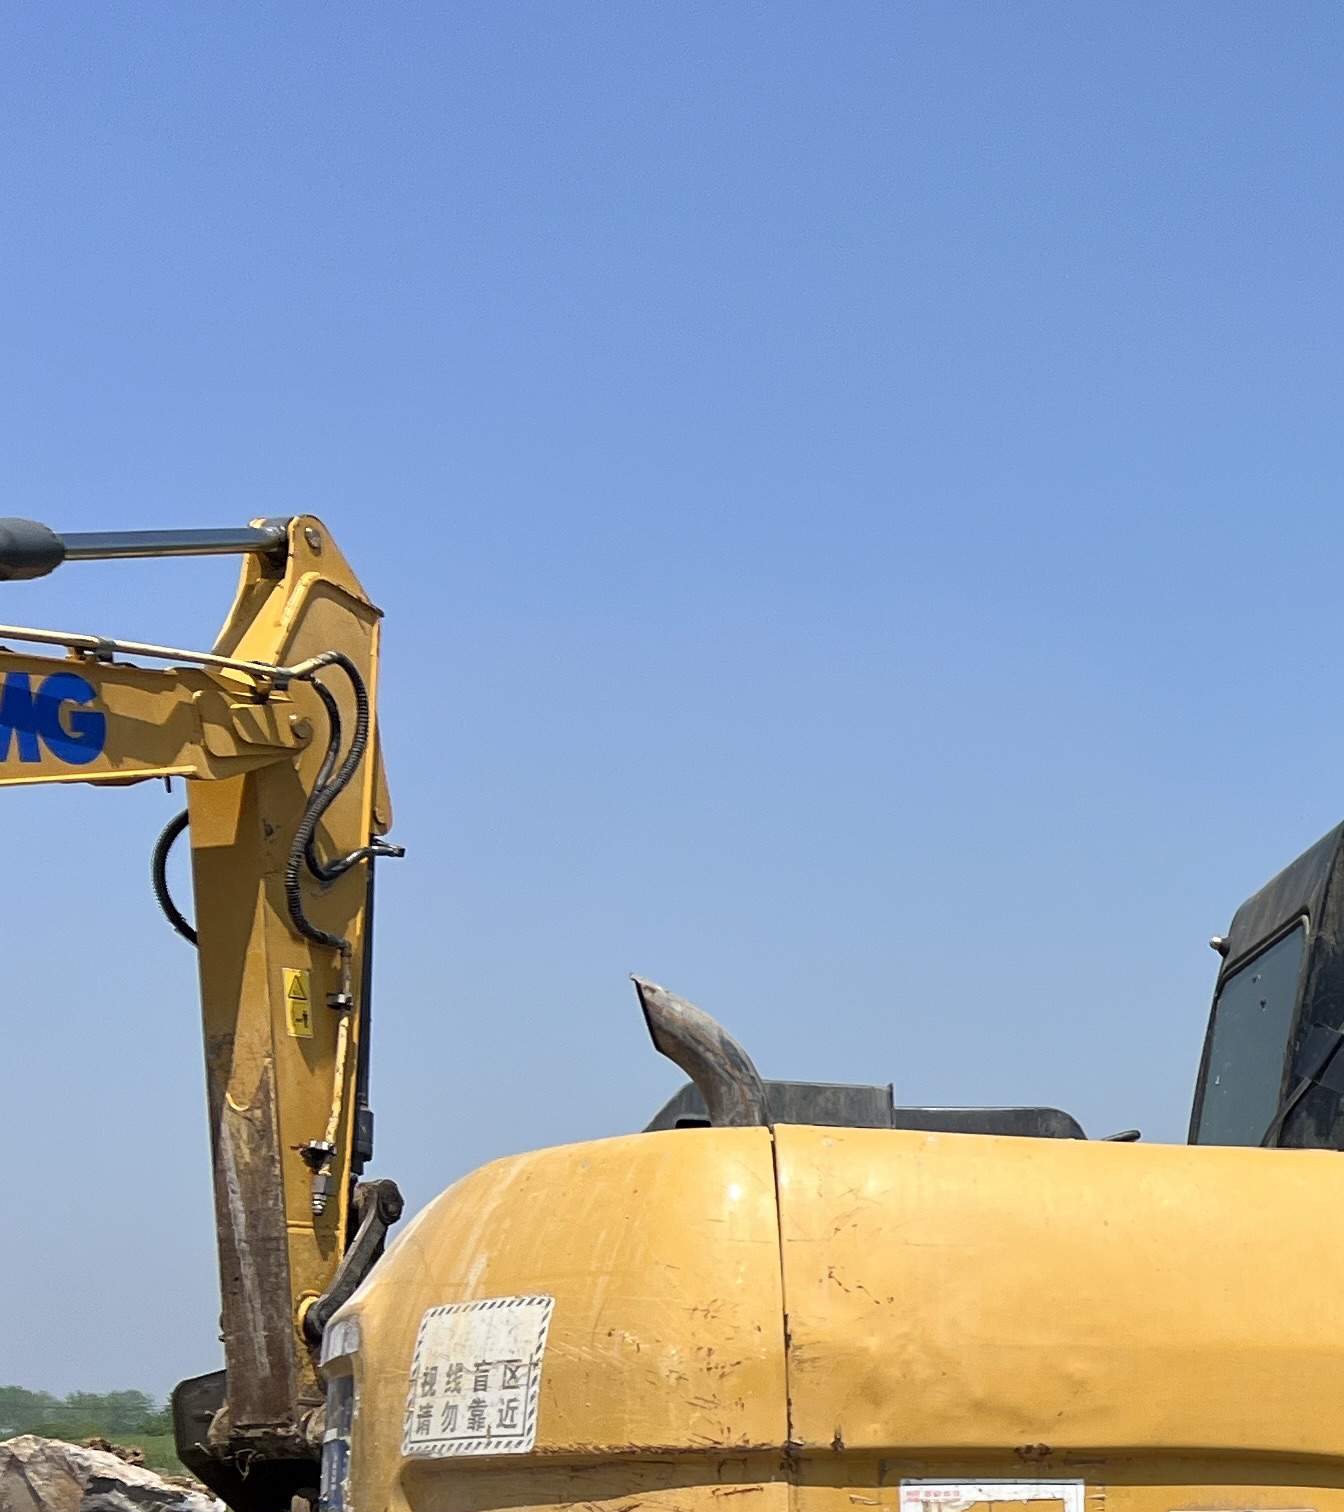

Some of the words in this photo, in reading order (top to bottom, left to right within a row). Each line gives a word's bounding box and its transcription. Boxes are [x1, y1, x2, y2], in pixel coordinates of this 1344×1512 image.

[421, 1359, 523, 1397] 视线盲区
[416, 1397, 520, 1436] 请勿靠近
